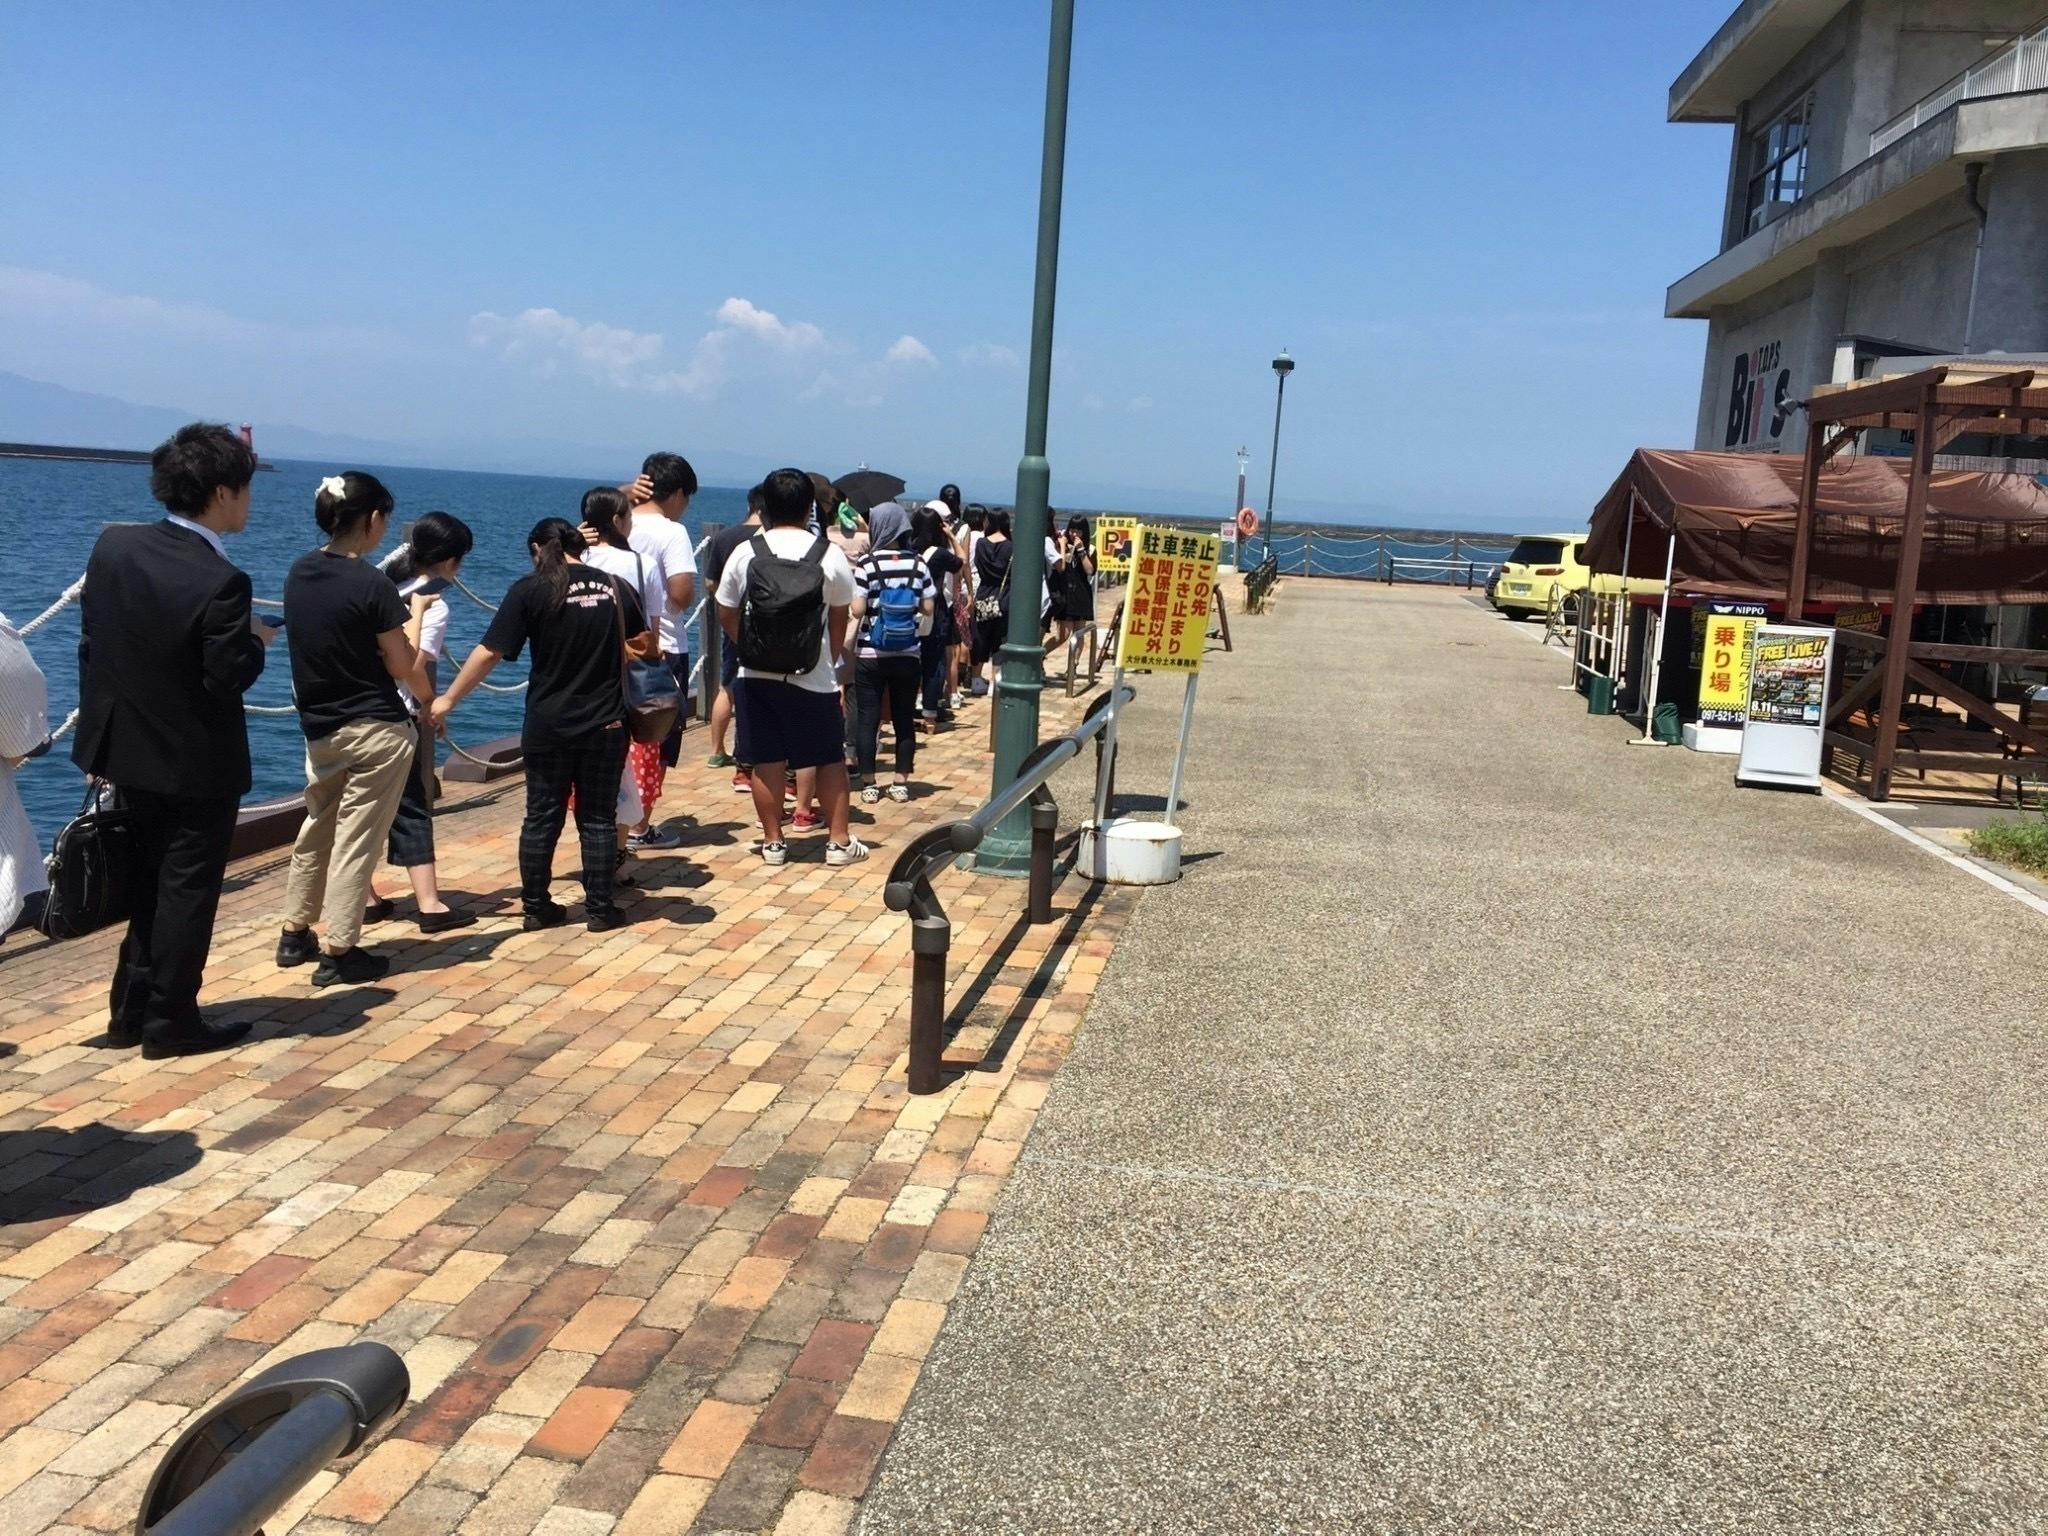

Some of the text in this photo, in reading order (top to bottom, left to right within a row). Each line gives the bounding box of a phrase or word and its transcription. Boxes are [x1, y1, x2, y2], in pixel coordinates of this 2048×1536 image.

[1099, 519, 1134, 528] 駐車禁止
[1143, 532, 1214, 561] 駐車禁止
[1130, 557, 1155, 636] 進入禁止
[1191, 565, 1211, 616] この先
[1169, 563, 1194, 655] 行き止まり
[1735, 606, 1764, 615] NIPPO
[1126, 655, 1197, 667] 大分県大分土木事務所
[1709, 626, 1736, 692] 乗り場
[1757, 645, 1786, 661] FREE
[1789, 640, 1826, 659] LIVE!!
[1751, 701, 1771, 713] 8.11
